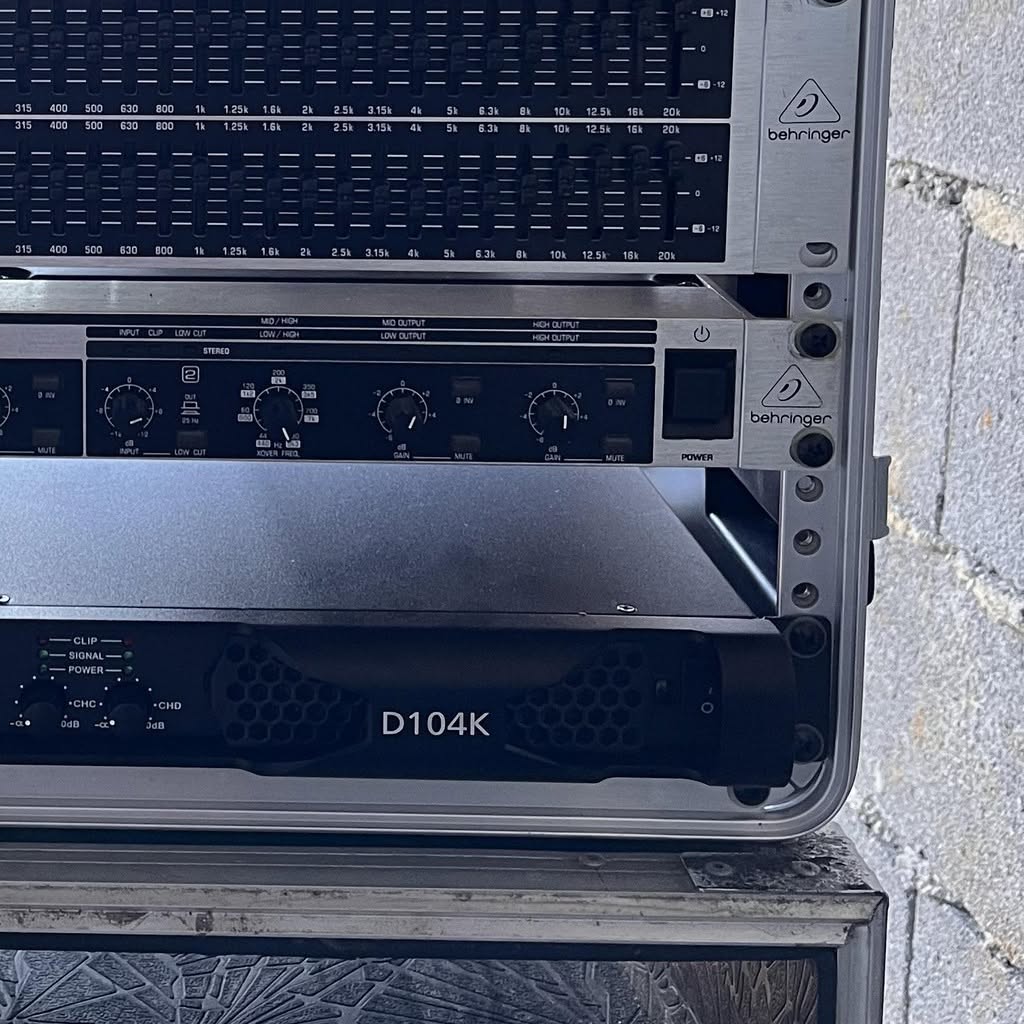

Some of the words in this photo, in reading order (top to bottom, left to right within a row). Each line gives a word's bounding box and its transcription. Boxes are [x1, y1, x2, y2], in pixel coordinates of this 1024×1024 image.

[767, 128, 852, 144] behringer
[202, 347, 230, 355] STEREO
[750, 410, 833, 428] behringer
[681, 453, 714, 462] POWER
[73, 636, 98, 646] CLIP
[68, 651, 105, 661] SIGNAL
[68, 665, 104, 675] POWER
[73, 699, 97, 709] CHC
[158, 701, 182, 710] CHD
[60, 720, 80, 728] 0dB
[381, 711, 491, 736] D104K
